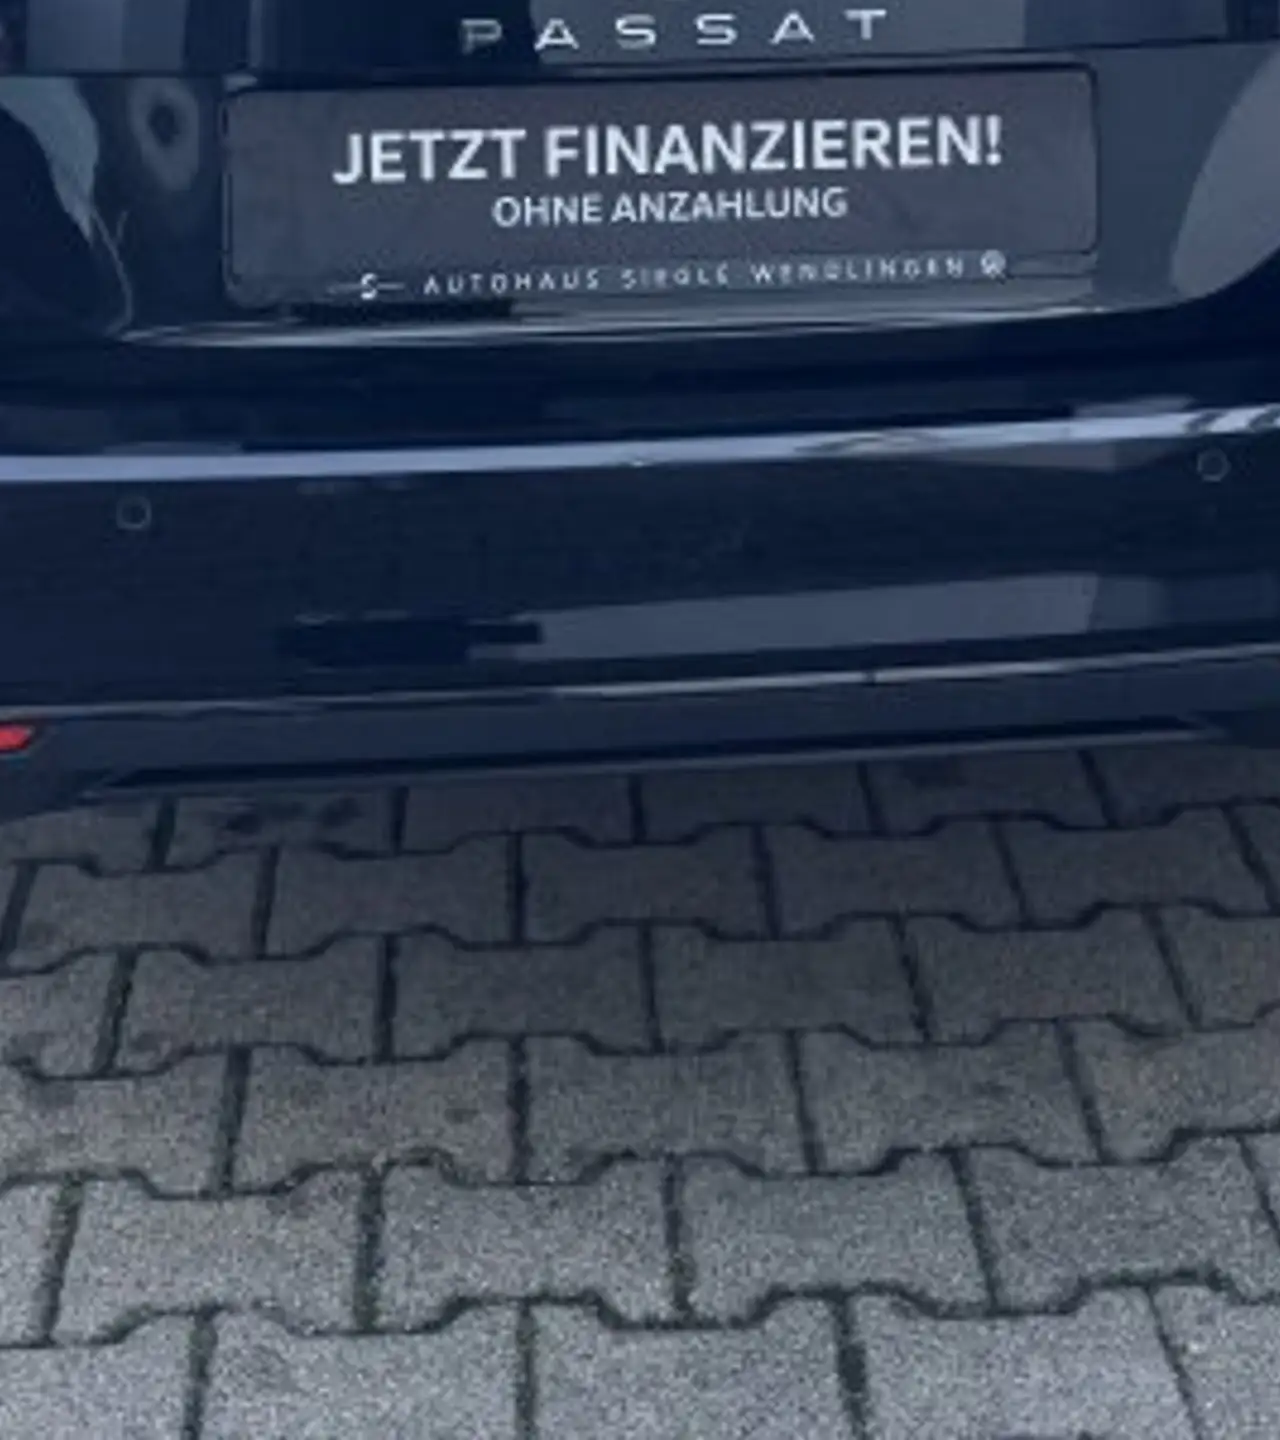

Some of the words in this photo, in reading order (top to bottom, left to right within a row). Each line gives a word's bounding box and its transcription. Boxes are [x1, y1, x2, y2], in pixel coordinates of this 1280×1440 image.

[460, 8, 887, 54] PASSAT
[332, 127, 527, 185] JETZT
[544, 113, 1002, 178] FINANZIEREN!
[491, 192, 604, 228] OHNE
[610, 186, 850, 224] ANZAHLUNG
[422, 268, 600, 296] AUTOHAUS
